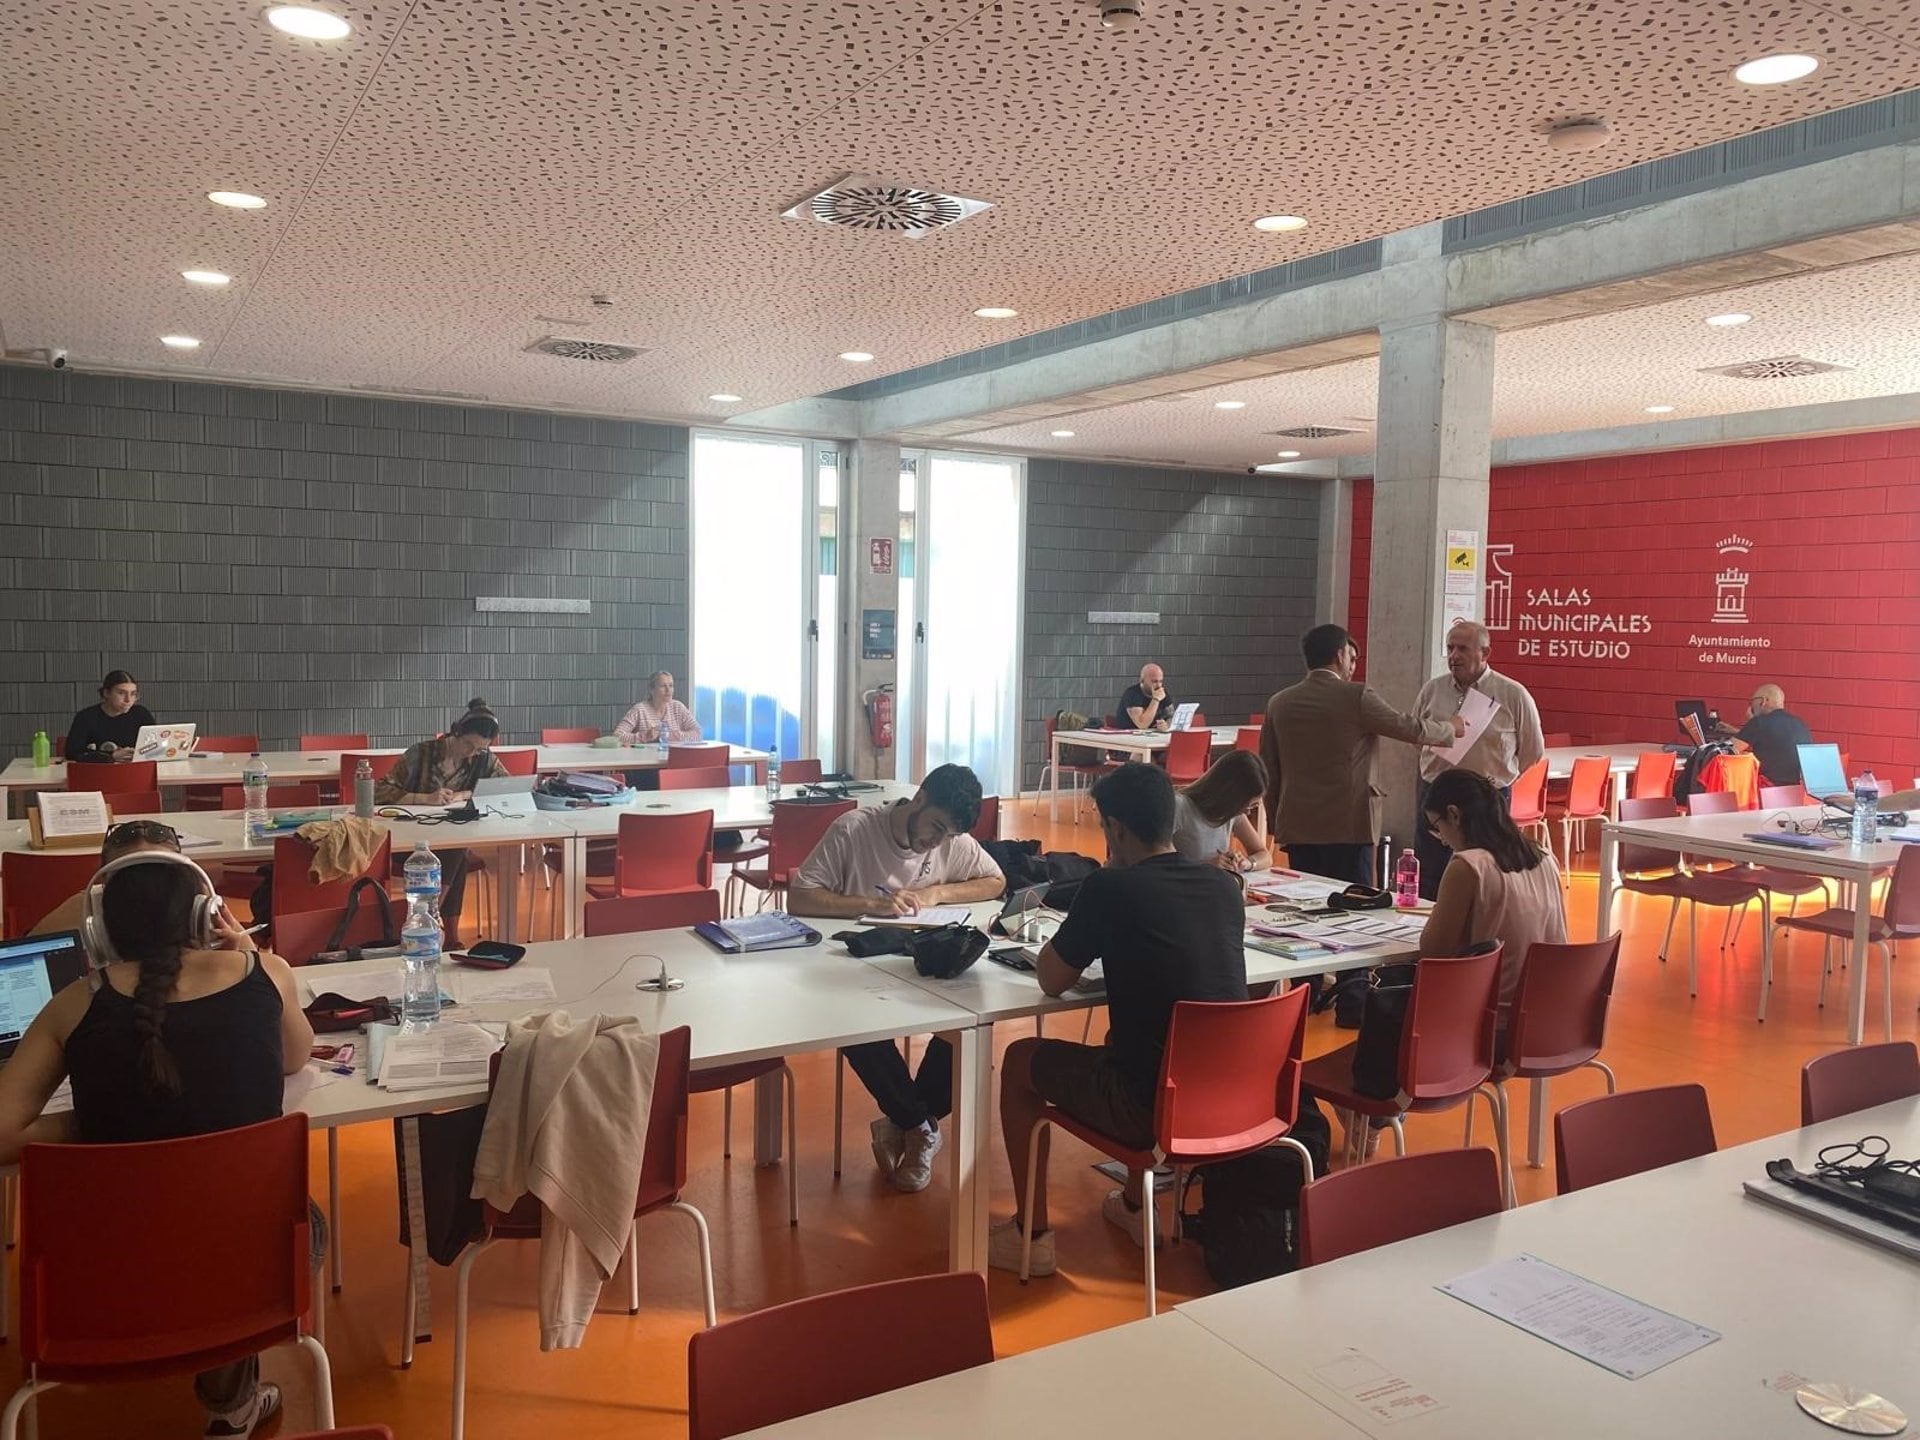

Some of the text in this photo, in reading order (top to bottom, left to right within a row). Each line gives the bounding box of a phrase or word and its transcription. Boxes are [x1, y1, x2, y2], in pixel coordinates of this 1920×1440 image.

[1526, 587, 1591, 606] SALAS
[1519, 613, 1652, 633] MUNICIPALES
[1518, 638, 1631, 659] DE ESTUDIO
[1688, 634, 1771, 648] Ayuntamiento
[1698, 652, 1757, 665] de Murcia
